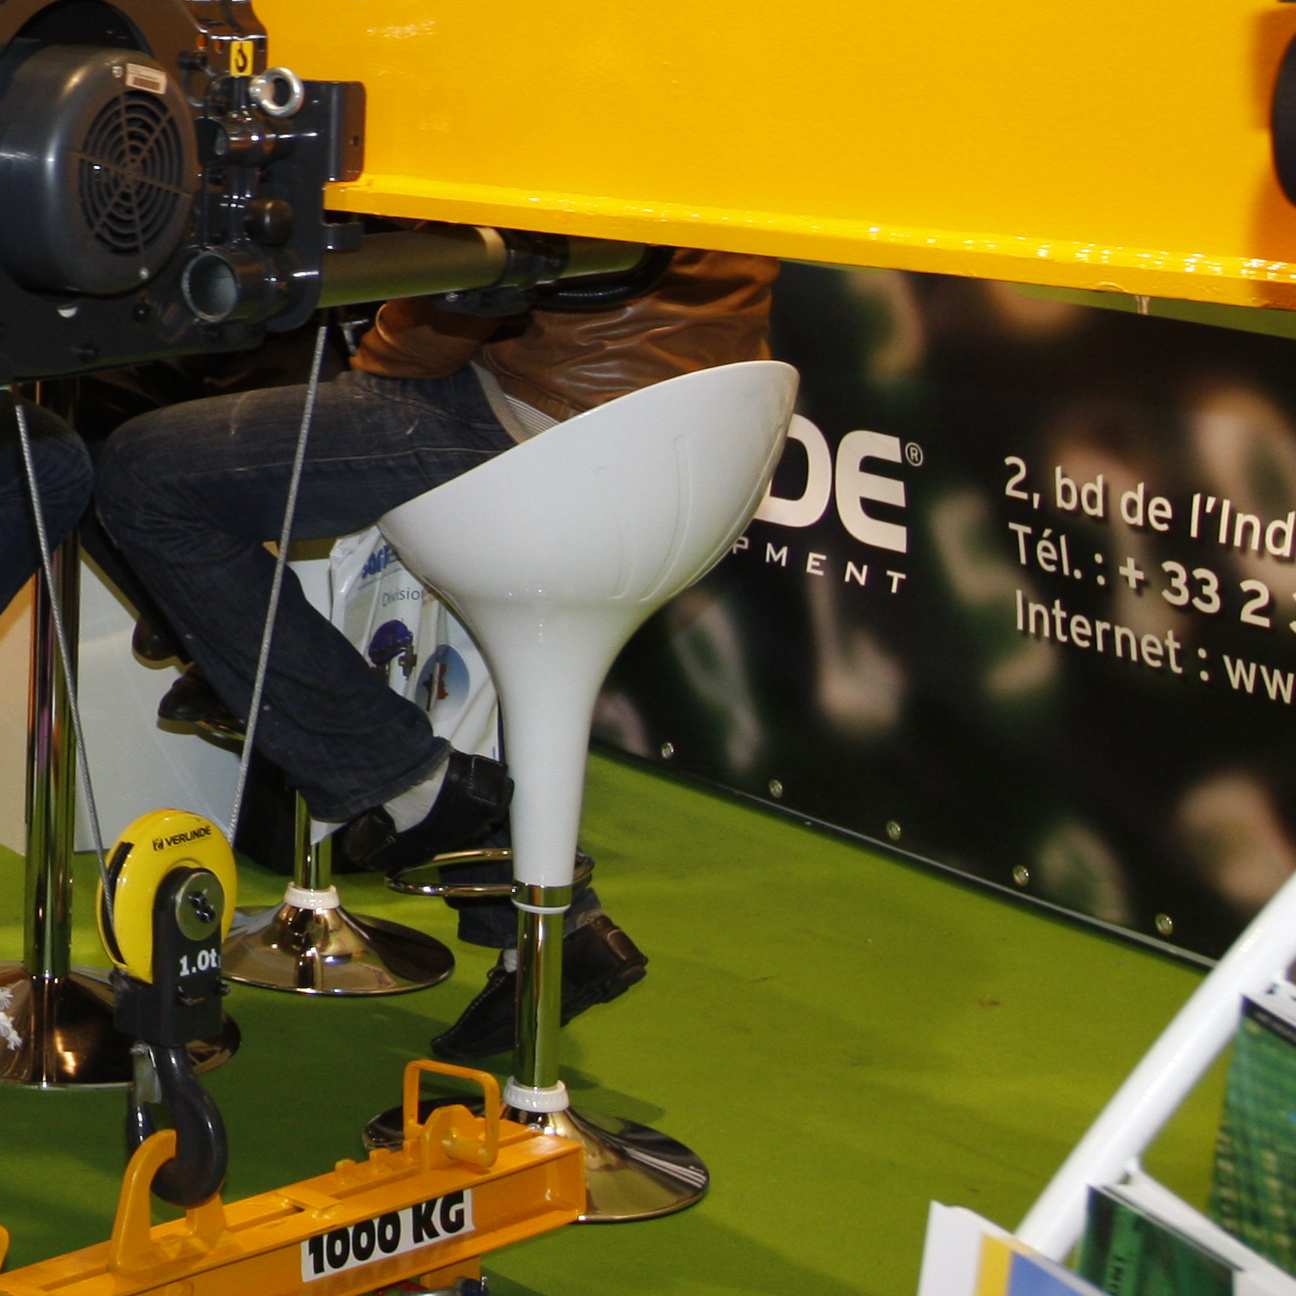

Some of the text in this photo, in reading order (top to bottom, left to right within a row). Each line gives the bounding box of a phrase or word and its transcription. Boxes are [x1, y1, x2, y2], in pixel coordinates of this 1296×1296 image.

[1004, 455, 1040, 509] 2,
[1055, 465, 1104, 518] bd
[1120, 482, 1173, 532] de
[1008, 521, 1083, 580] Tél.
[1161, 560, 1222, 614] 33
[1239, 579, 1271, 628] 2
[1016, 589, 1183, 674] Internet
[165, 825, 212, 846] VERLINDE
[308, 1189, 465, 1275] 1000 KG
